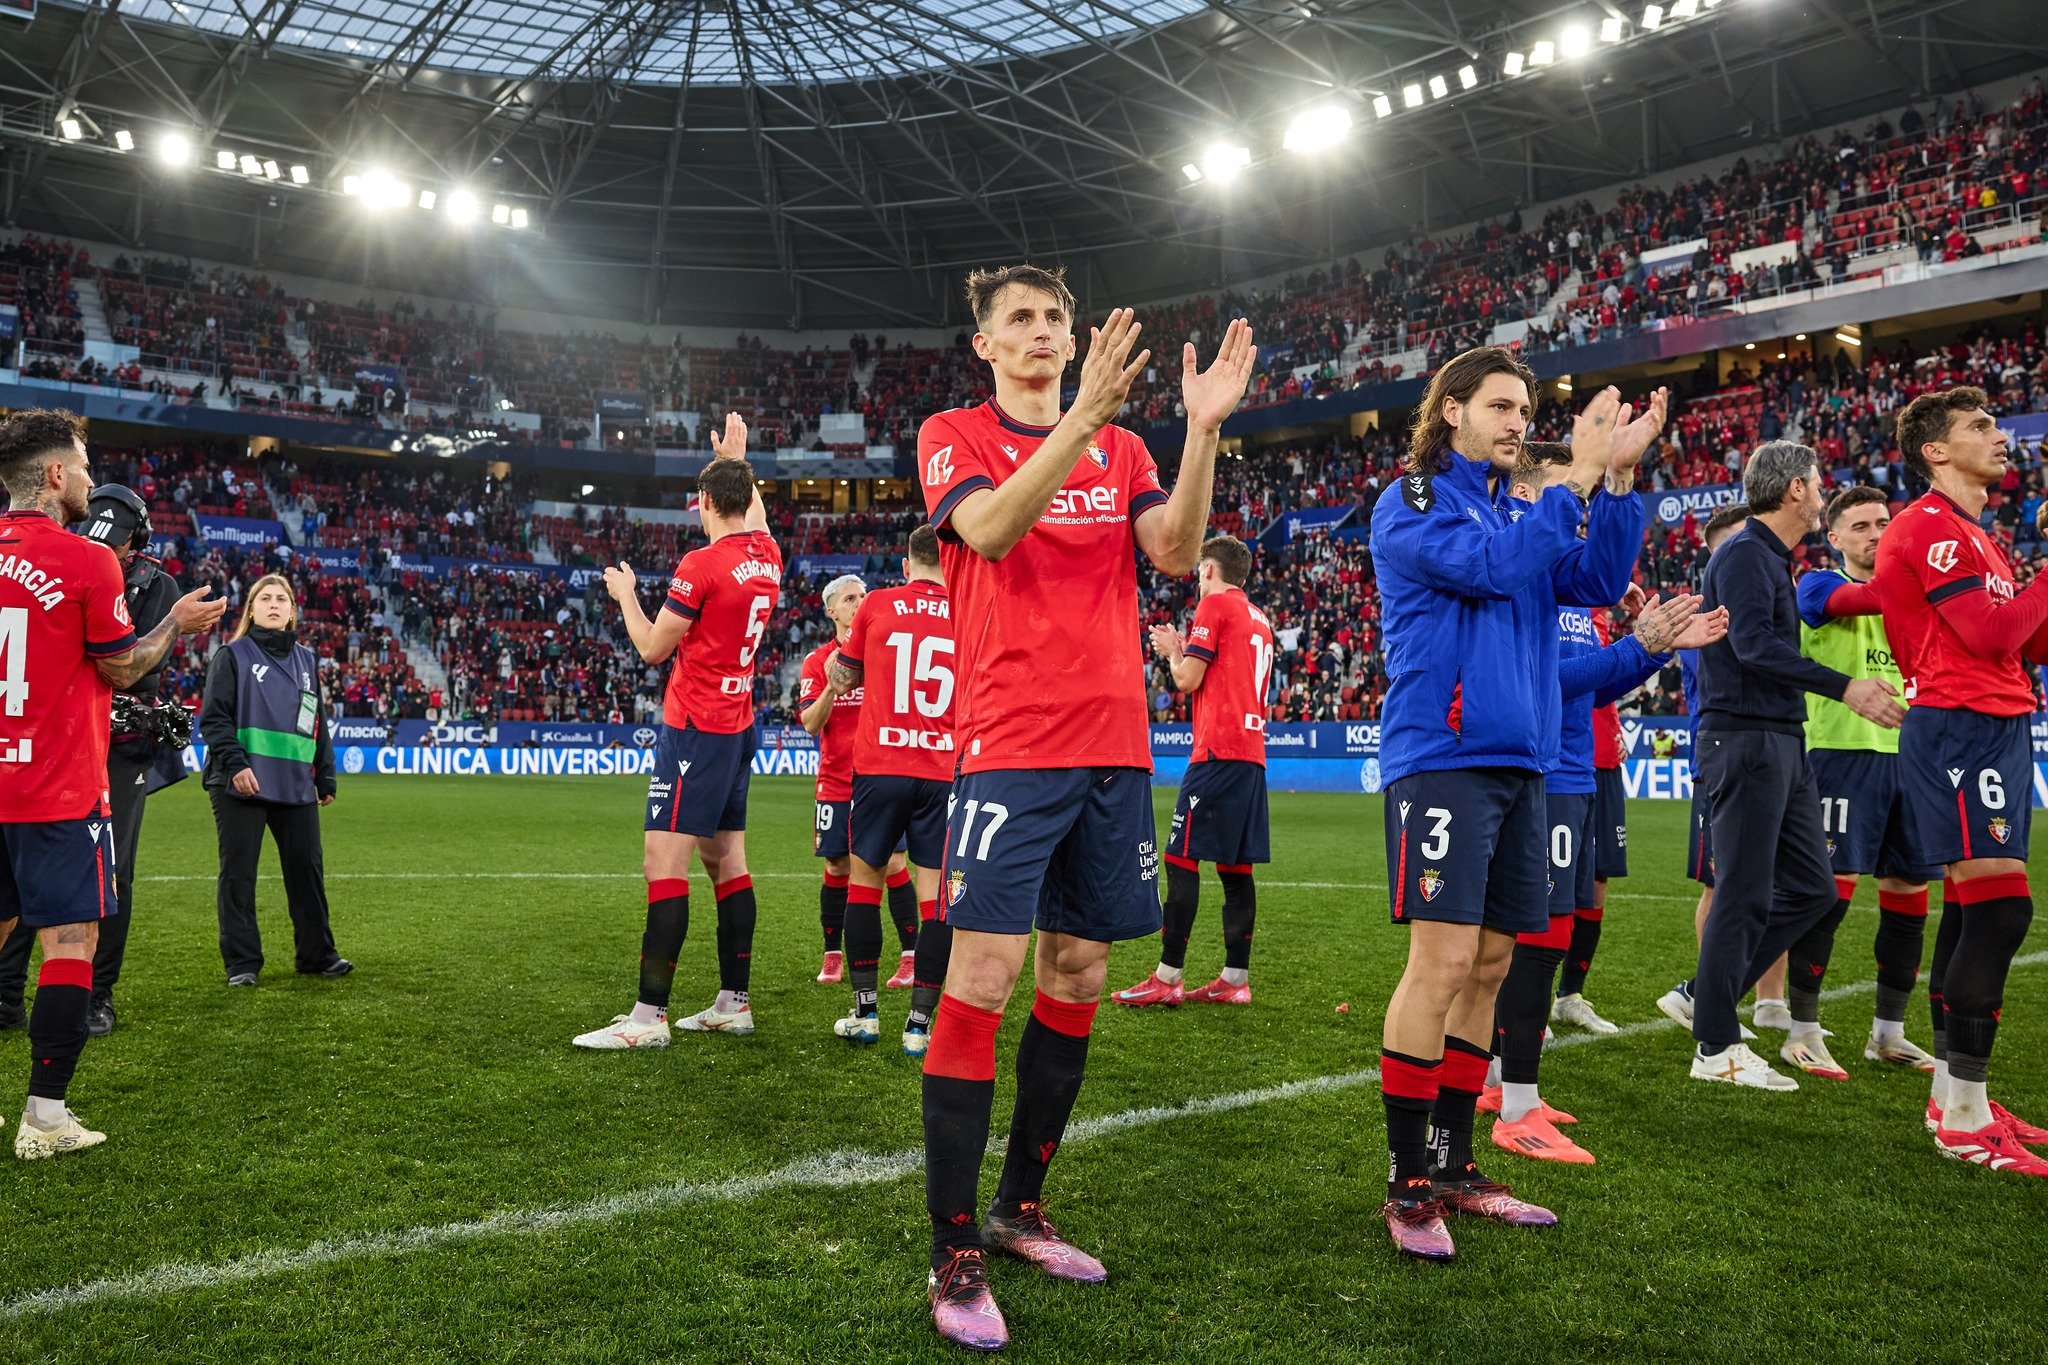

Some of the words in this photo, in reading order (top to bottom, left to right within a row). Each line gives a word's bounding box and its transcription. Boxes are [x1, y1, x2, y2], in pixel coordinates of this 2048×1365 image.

[202, 525, 264, 545] SanMiguel
[893, 599, 914, 616] R.
[916, 598, 950, 619] PEÑ
[739, 595, 770, 668] 5
[885, 631, 955, 718] 15
[1866, 649, 1898, 666] KOS
[1154, 732, 1194, 745] PAMPLO
[1346, 725, 1380, 744] KOS
[501, 748, 655, 775] UNIVERSIDA
[1621, 758, 1694, 799] VER
[1978, 768, 2006, 810] 6
[815, 804, 834, 831] 19
[957, 799, 1009, 861] 17
[1421, 807, 1452, 860] 3
[1820, 797, 1849, 834] 11
[1551, 824, 1572, 868] 0
